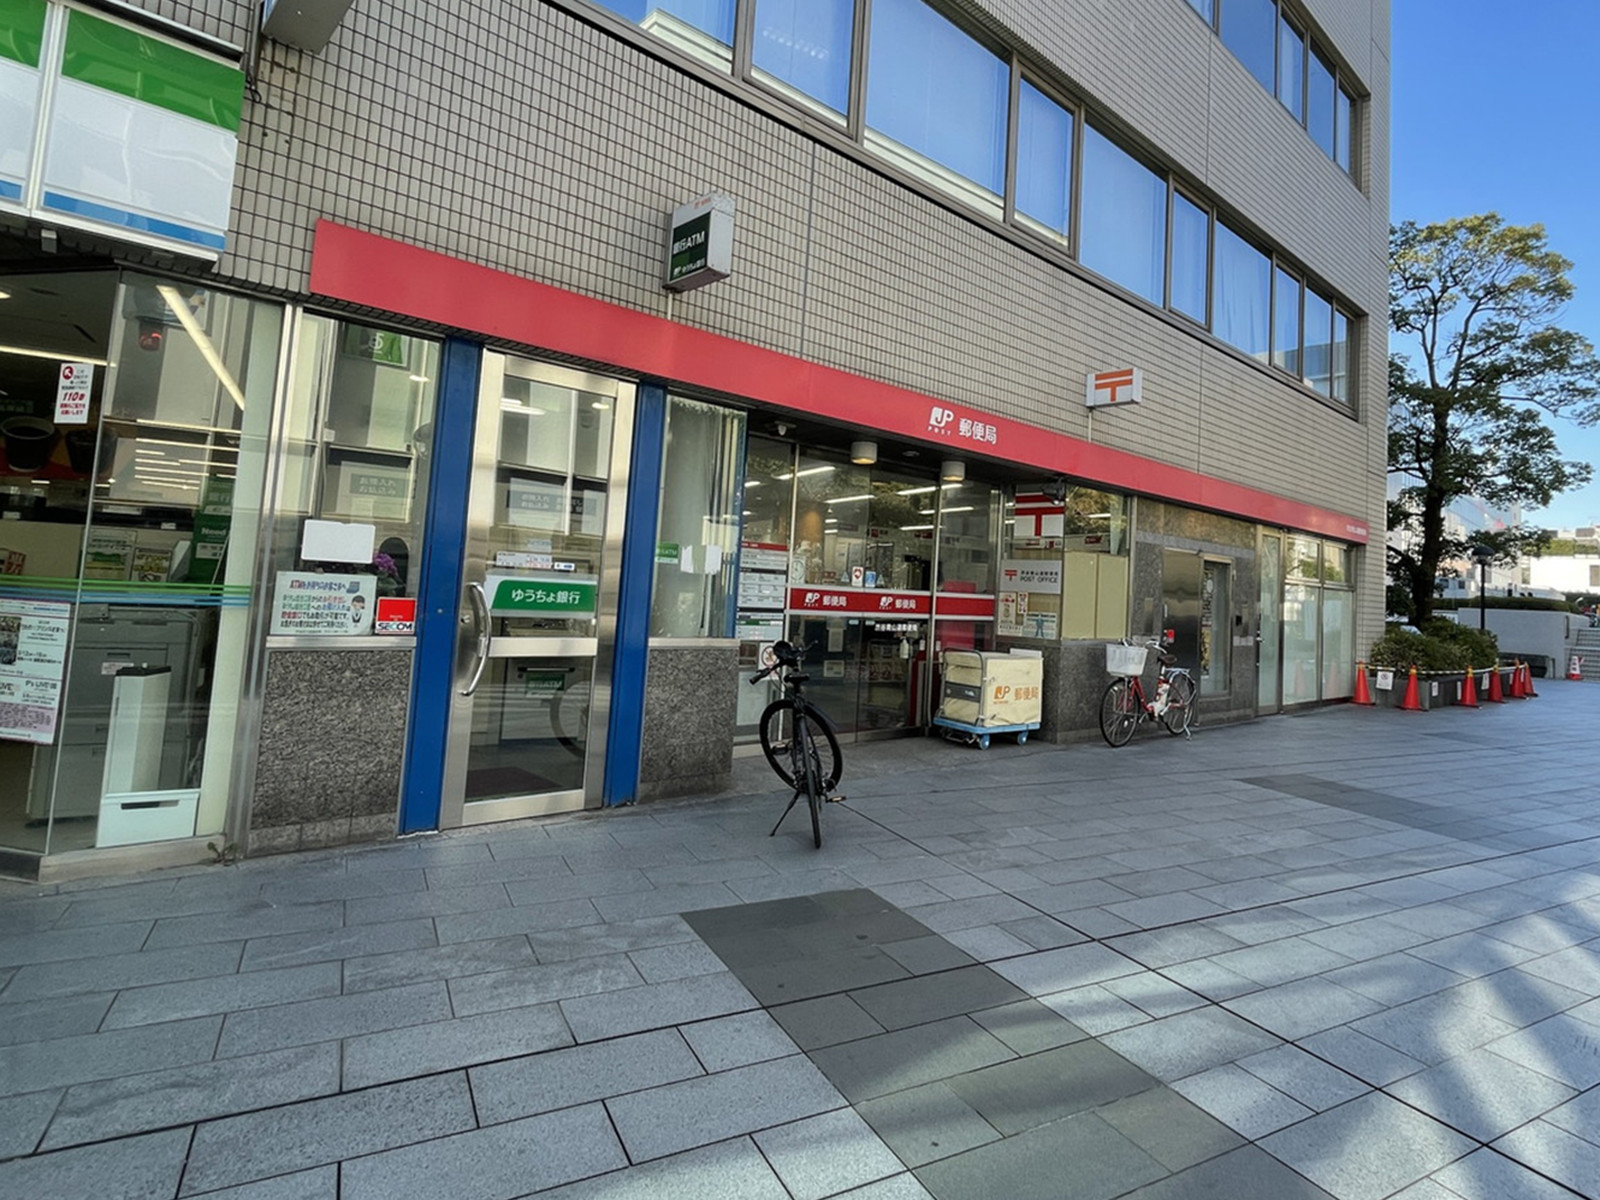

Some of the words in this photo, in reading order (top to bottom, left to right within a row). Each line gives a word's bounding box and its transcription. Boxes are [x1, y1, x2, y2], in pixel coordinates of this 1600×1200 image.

[959, 417, 997, 445] 郵便局
[511, 588, 581, 605] ゆうちょ銀行
[822, 594, 848, 607] 郵便局
[895, 599, 917, 609] 郵便局
[376, 621, 413, 631] SECOM
